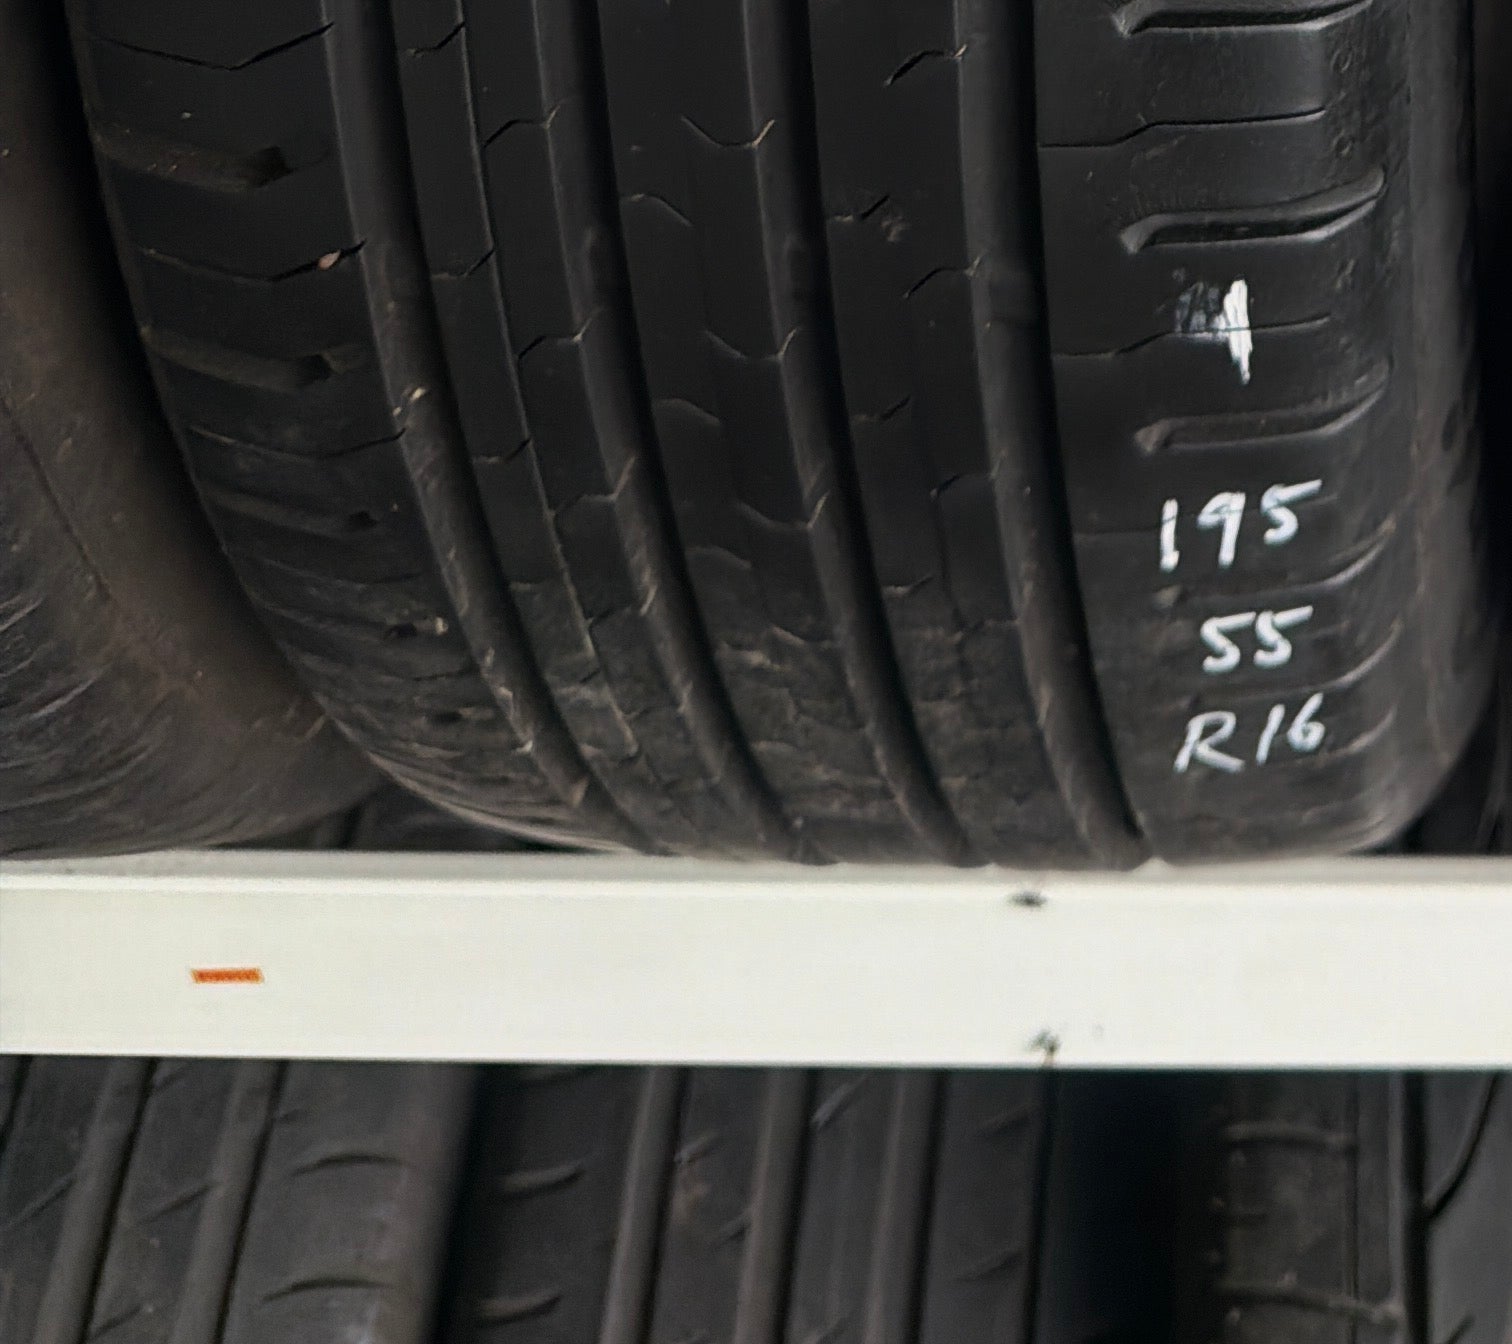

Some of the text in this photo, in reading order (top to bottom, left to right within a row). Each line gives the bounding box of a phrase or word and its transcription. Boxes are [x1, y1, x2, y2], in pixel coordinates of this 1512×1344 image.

[1160, 479, 1322, 572] 195
[1200, 605, 1313, 674] 55
[1173, 692, 1326, 773] R16
